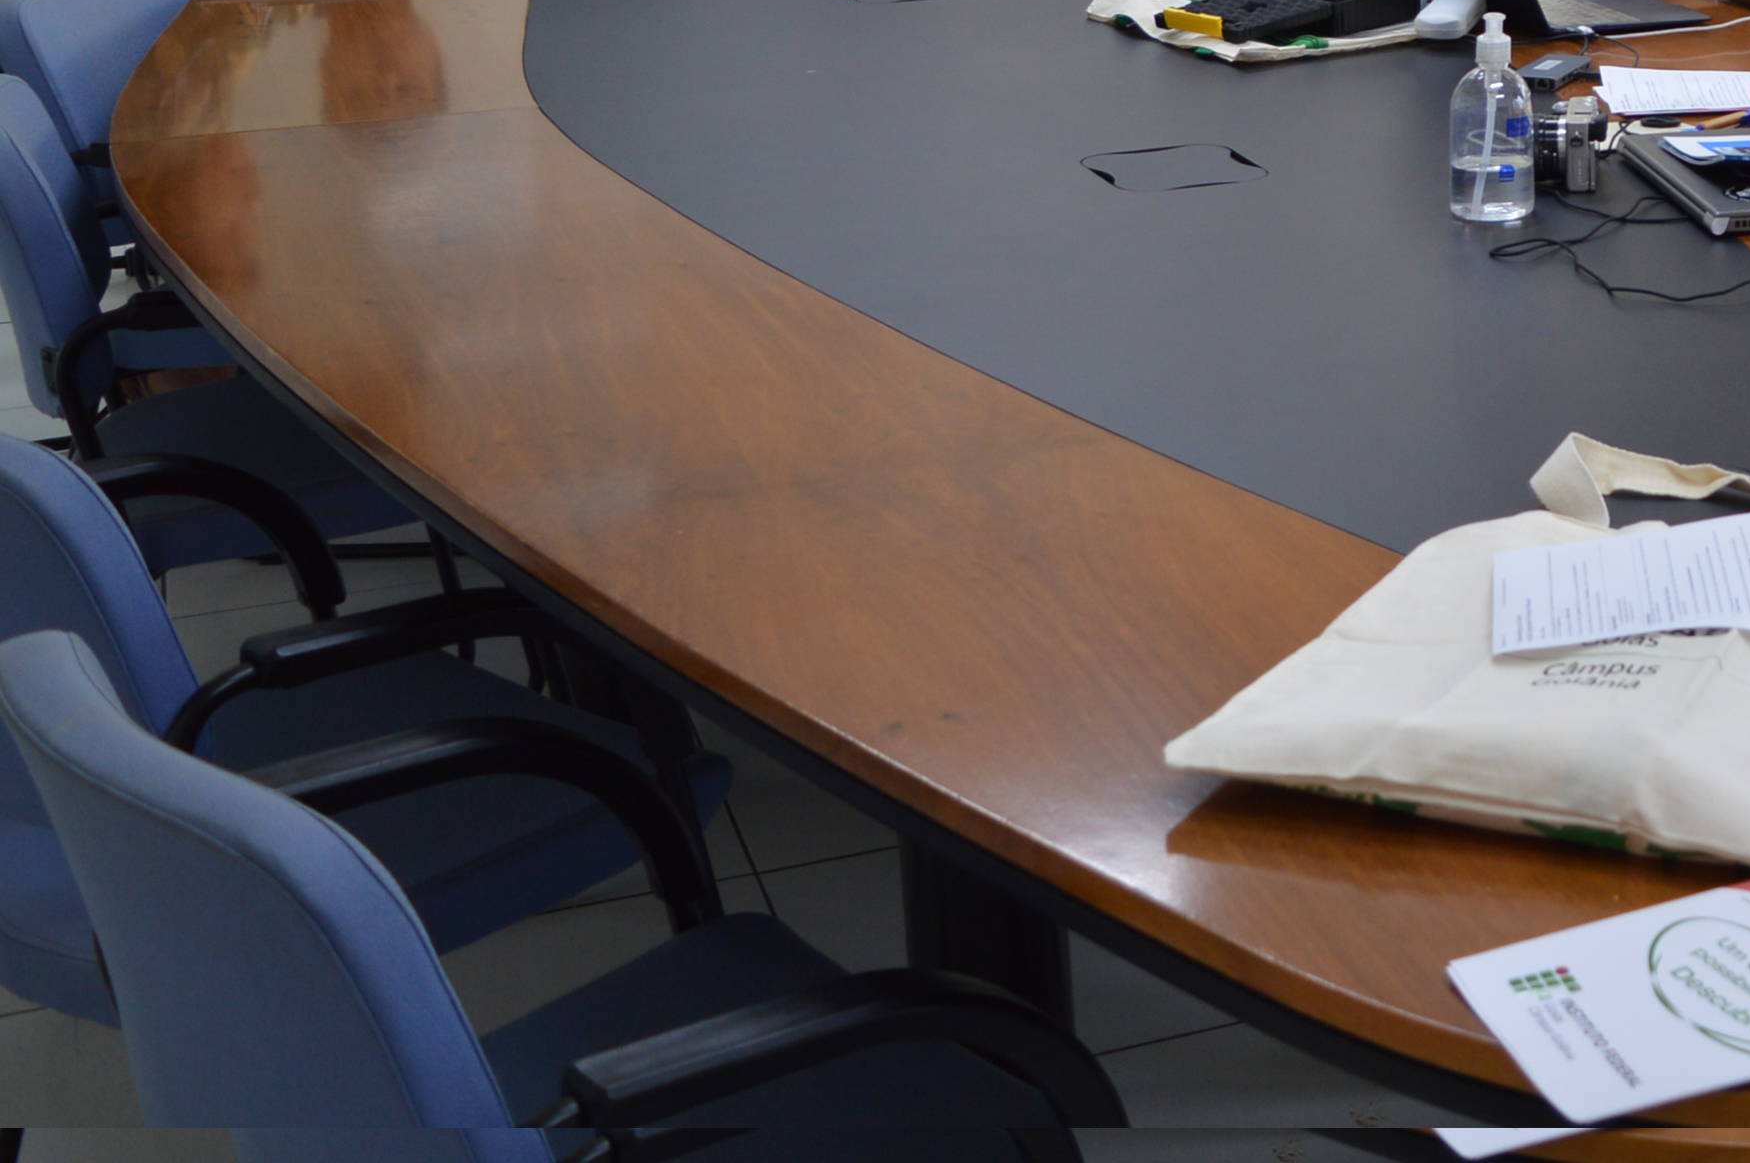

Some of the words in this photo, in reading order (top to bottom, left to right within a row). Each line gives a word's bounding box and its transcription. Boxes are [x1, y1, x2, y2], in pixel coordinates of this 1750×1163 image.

[1543, 660, 1661, 678] Câmpus
[1717, 936, 1747, 963] Um
[1559, 997, 1609, 1049] INSTITUTO
[1602, 1047, 1645, 1089] FEDERAL
